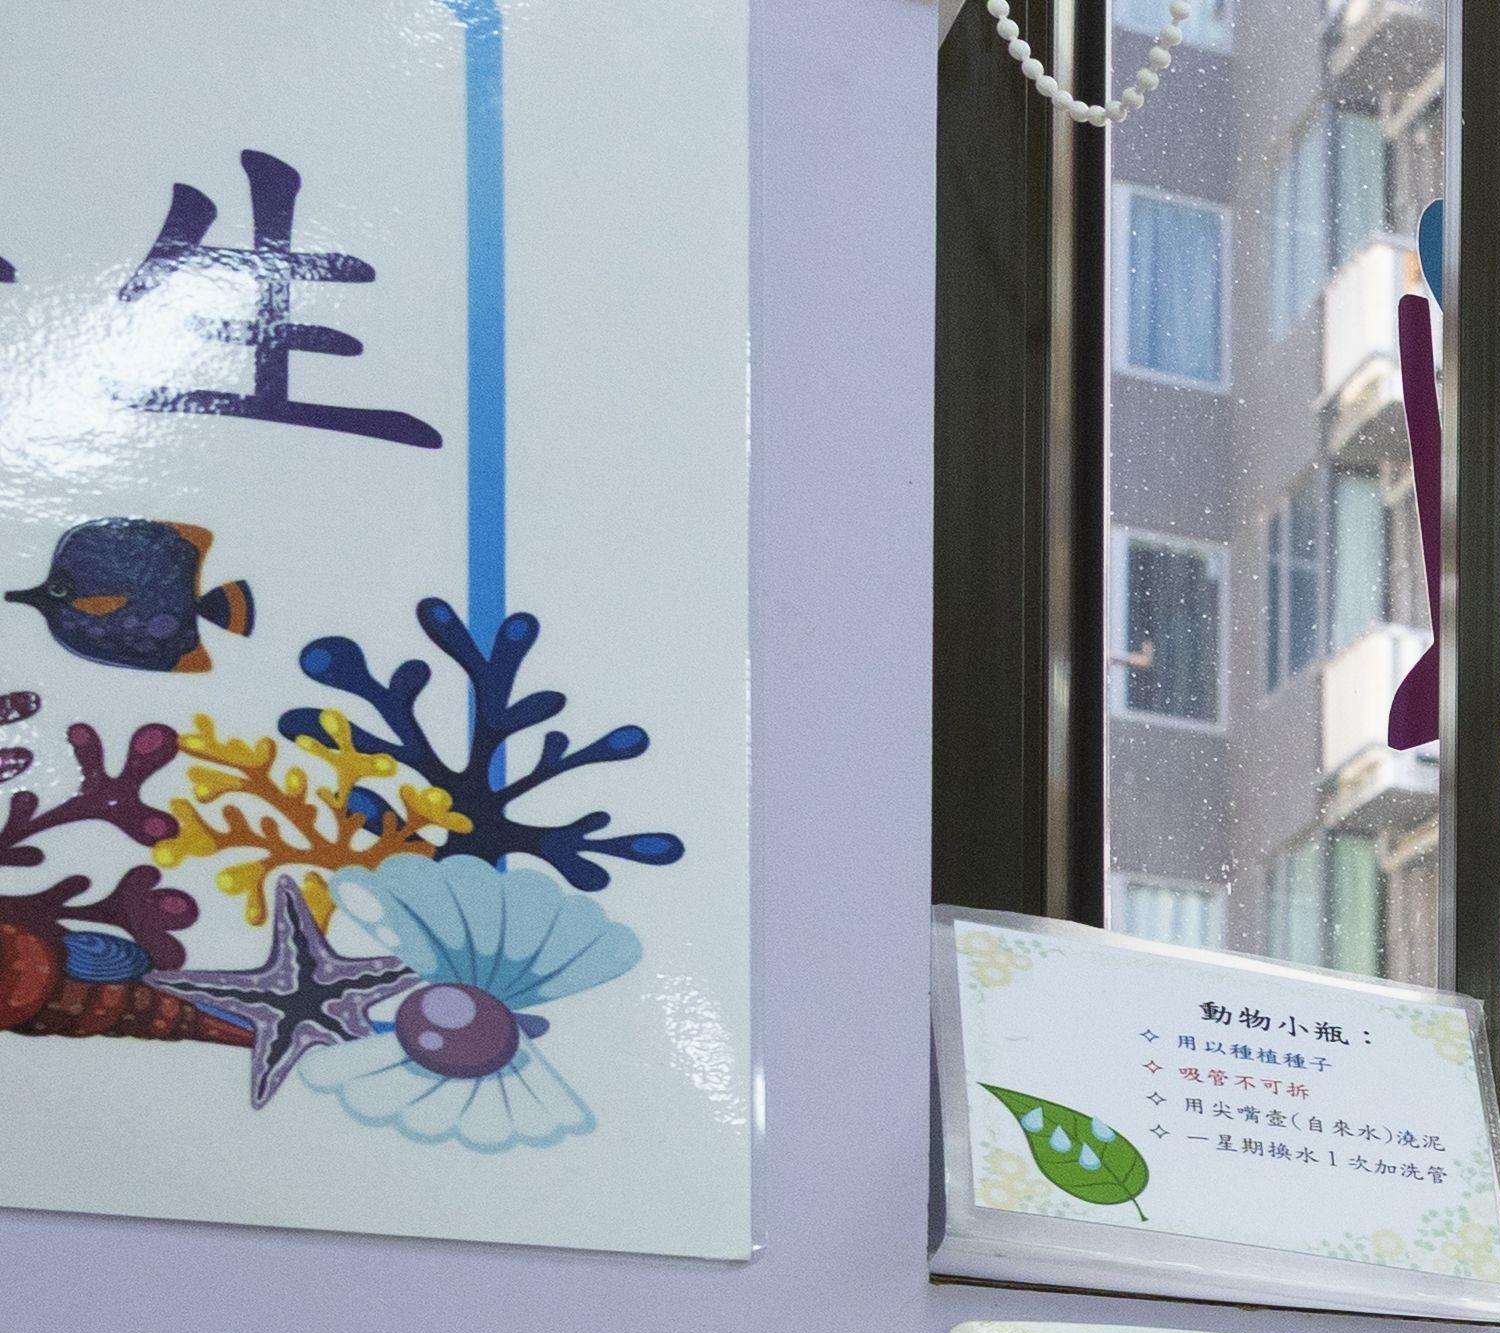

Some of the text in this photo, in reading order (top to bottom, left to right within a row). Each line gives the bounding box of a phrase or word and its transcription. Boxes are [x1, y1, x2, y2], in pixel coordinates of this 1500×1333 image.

[0, 147, 444, 450] 生
[1177, 1034, 1333, 1073] 用以種植種子
[1178, 1066, 1311, 1101] 吸管不可拆
